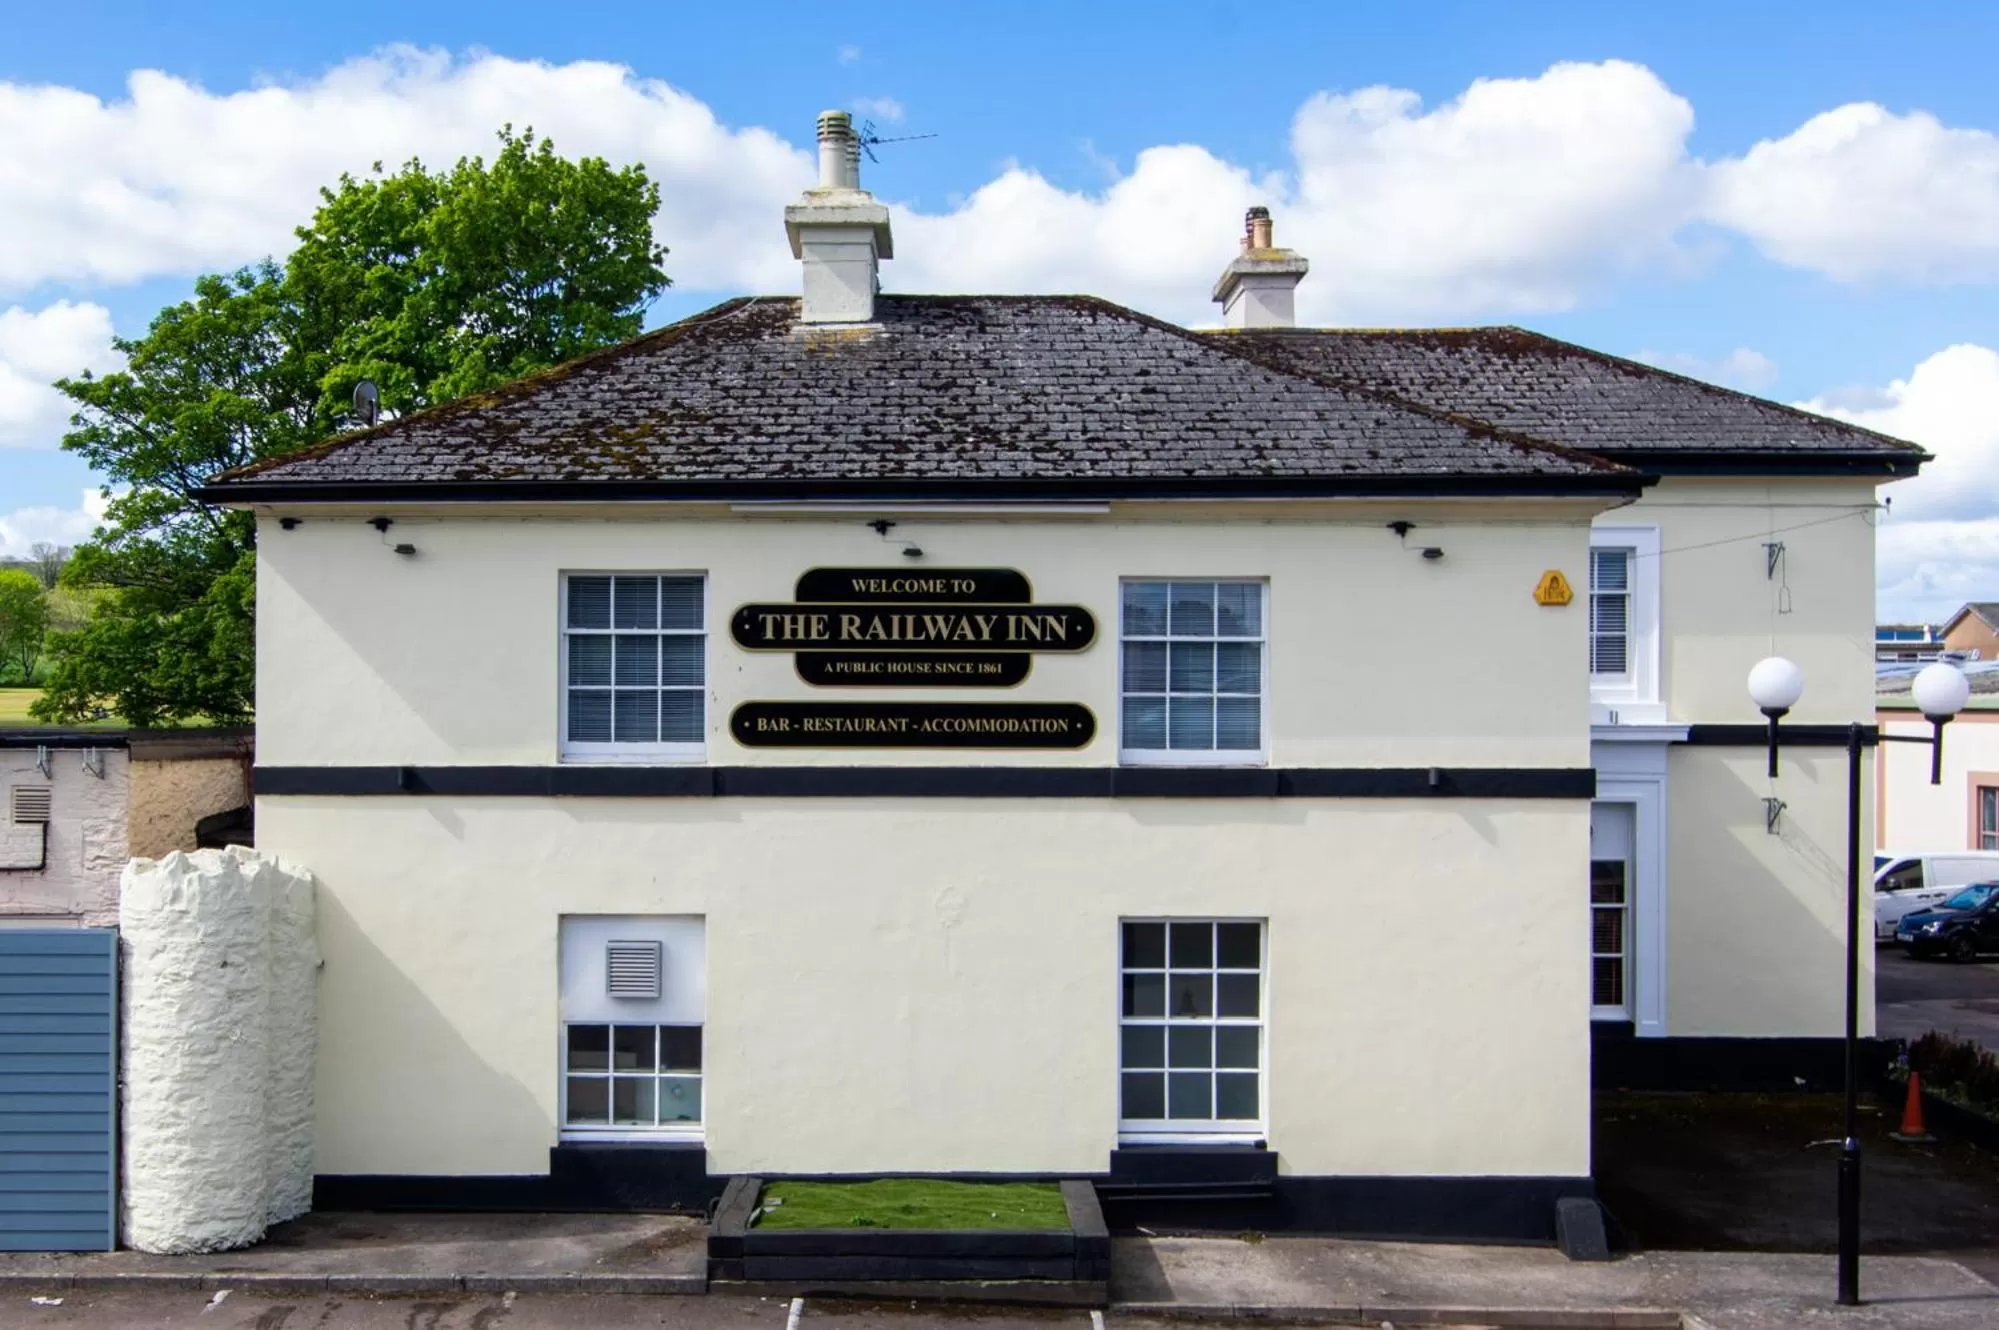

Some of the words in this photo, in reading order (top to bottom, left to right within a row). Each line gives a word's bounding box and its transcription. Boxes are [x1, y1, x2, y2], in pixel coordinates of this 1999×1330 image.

[852, 579, 946, 593] WELCOME
[951, 579, 976, 593] TO
[758, 614, 830, 640] THE
[840, 614, 998, 641] RAILWAY
[1007, 615, 1068, 641] INN
[824, 663, 833, 673] A
[836, 662, 883, 673] PUBLIC
[887, 662, 932, 673] HOUSE
[935, 663, 975, 673] SINCE
[978, 663, 1003, 674] 1861
[757, 718, 790, 731] BAR
[803, 718, 910, 732] RESTAURANT
[921, 718, 1068, 732] ACCOMMODATION
